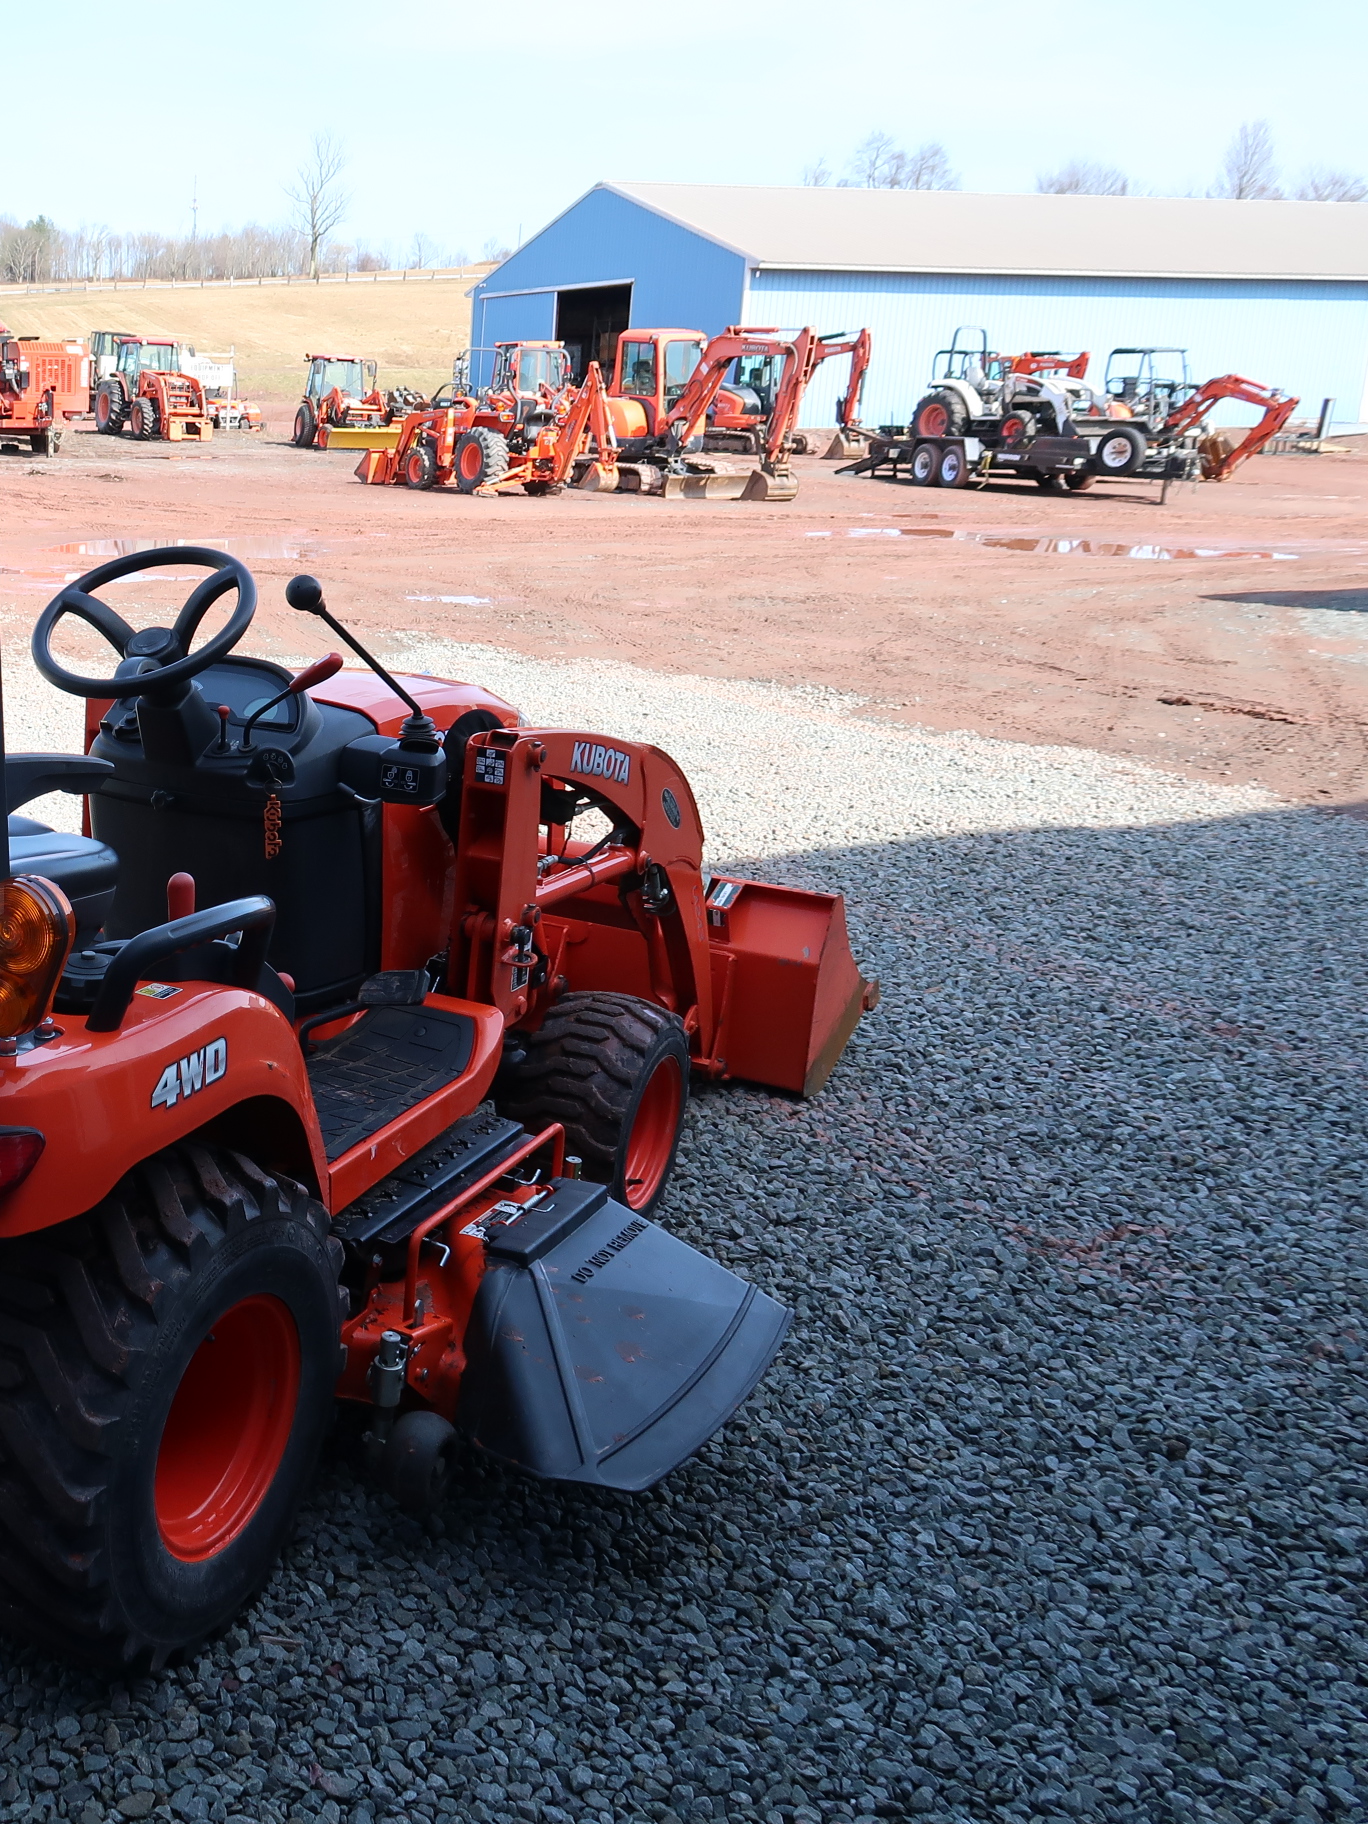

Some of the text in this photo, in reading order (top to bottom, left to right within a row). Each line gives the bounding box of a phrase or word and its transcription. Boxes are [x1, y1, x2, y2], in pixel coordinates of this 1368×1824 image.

[190, 364, 224, 372] EQUIPMENT
[741, 343, 769, 353] KUBOTA
[570, 741, 631, 786] KUBOTA
[264, 801, 282, 859] Kubota
[151, 1037, 228, 1109] 4WD
[570, 1218, 649, 1284] DO NOT REMOVE
